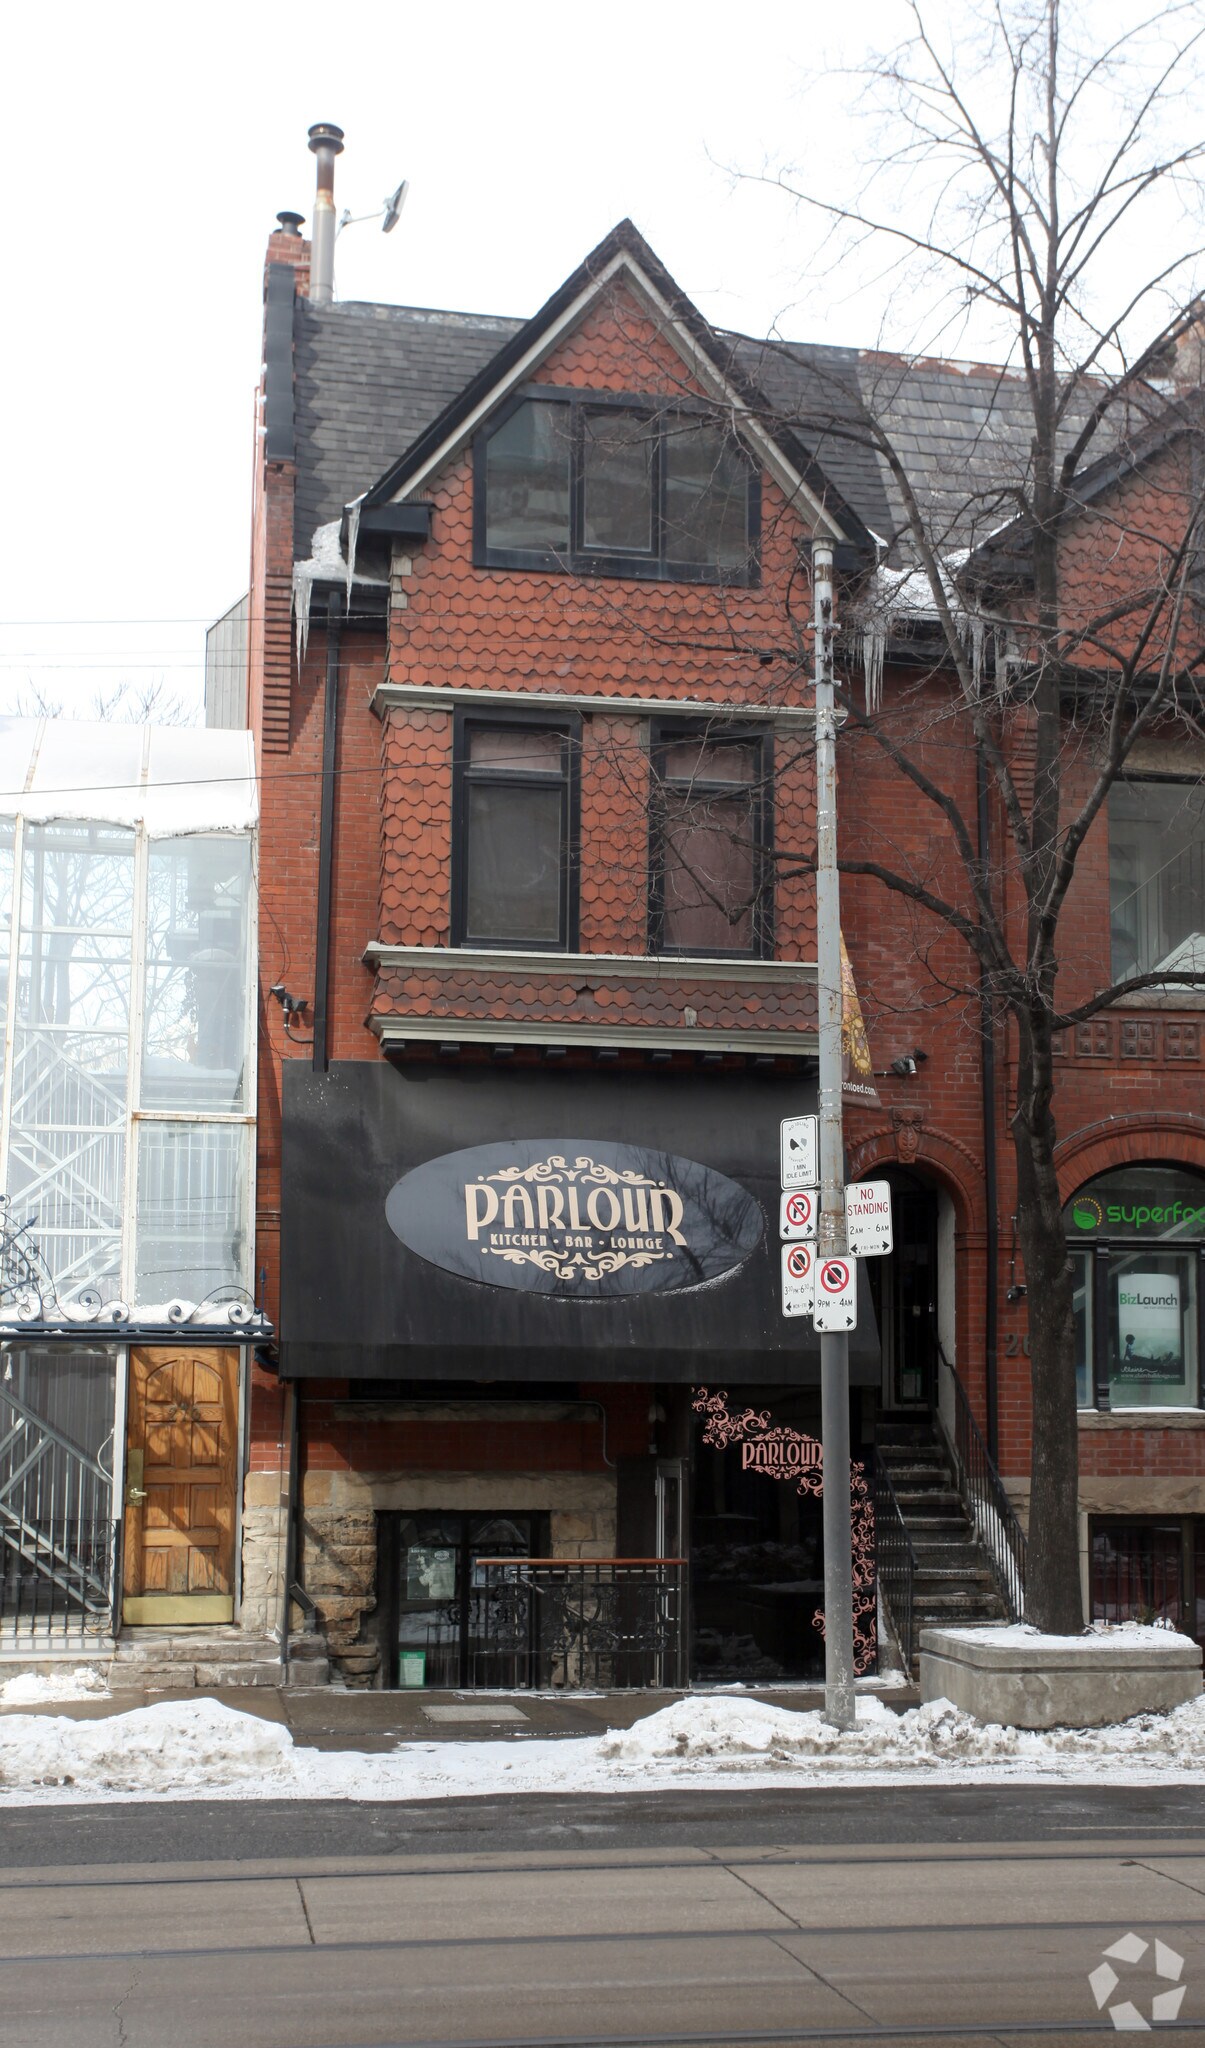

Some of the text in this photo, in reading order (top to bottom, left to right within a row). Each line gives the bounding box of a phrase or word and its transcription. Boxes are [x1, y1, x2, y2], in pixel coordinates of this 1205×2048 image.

[786, 1169, 812, 1179] IDLE LIMIT
[860, 1188, 874, 1200] NO
[465, 1184, 687, 1246] PARLOUR
[847, 1201, 889, 1217] STANDING
[849, 1225, 864, 1235] 2AM
[875, 1223, 890, 1233] 6AM
[490, 1233, 663, 1250] KITCHEN BAR LOUNGE
[817, 1298, 831, 1308] 9PM
[839, 1298, 853, 1308] 4AM
[1119, 1292, 1178, 1306] BizLaunch
[742, 1442, 824, 1470] PARLOUR
